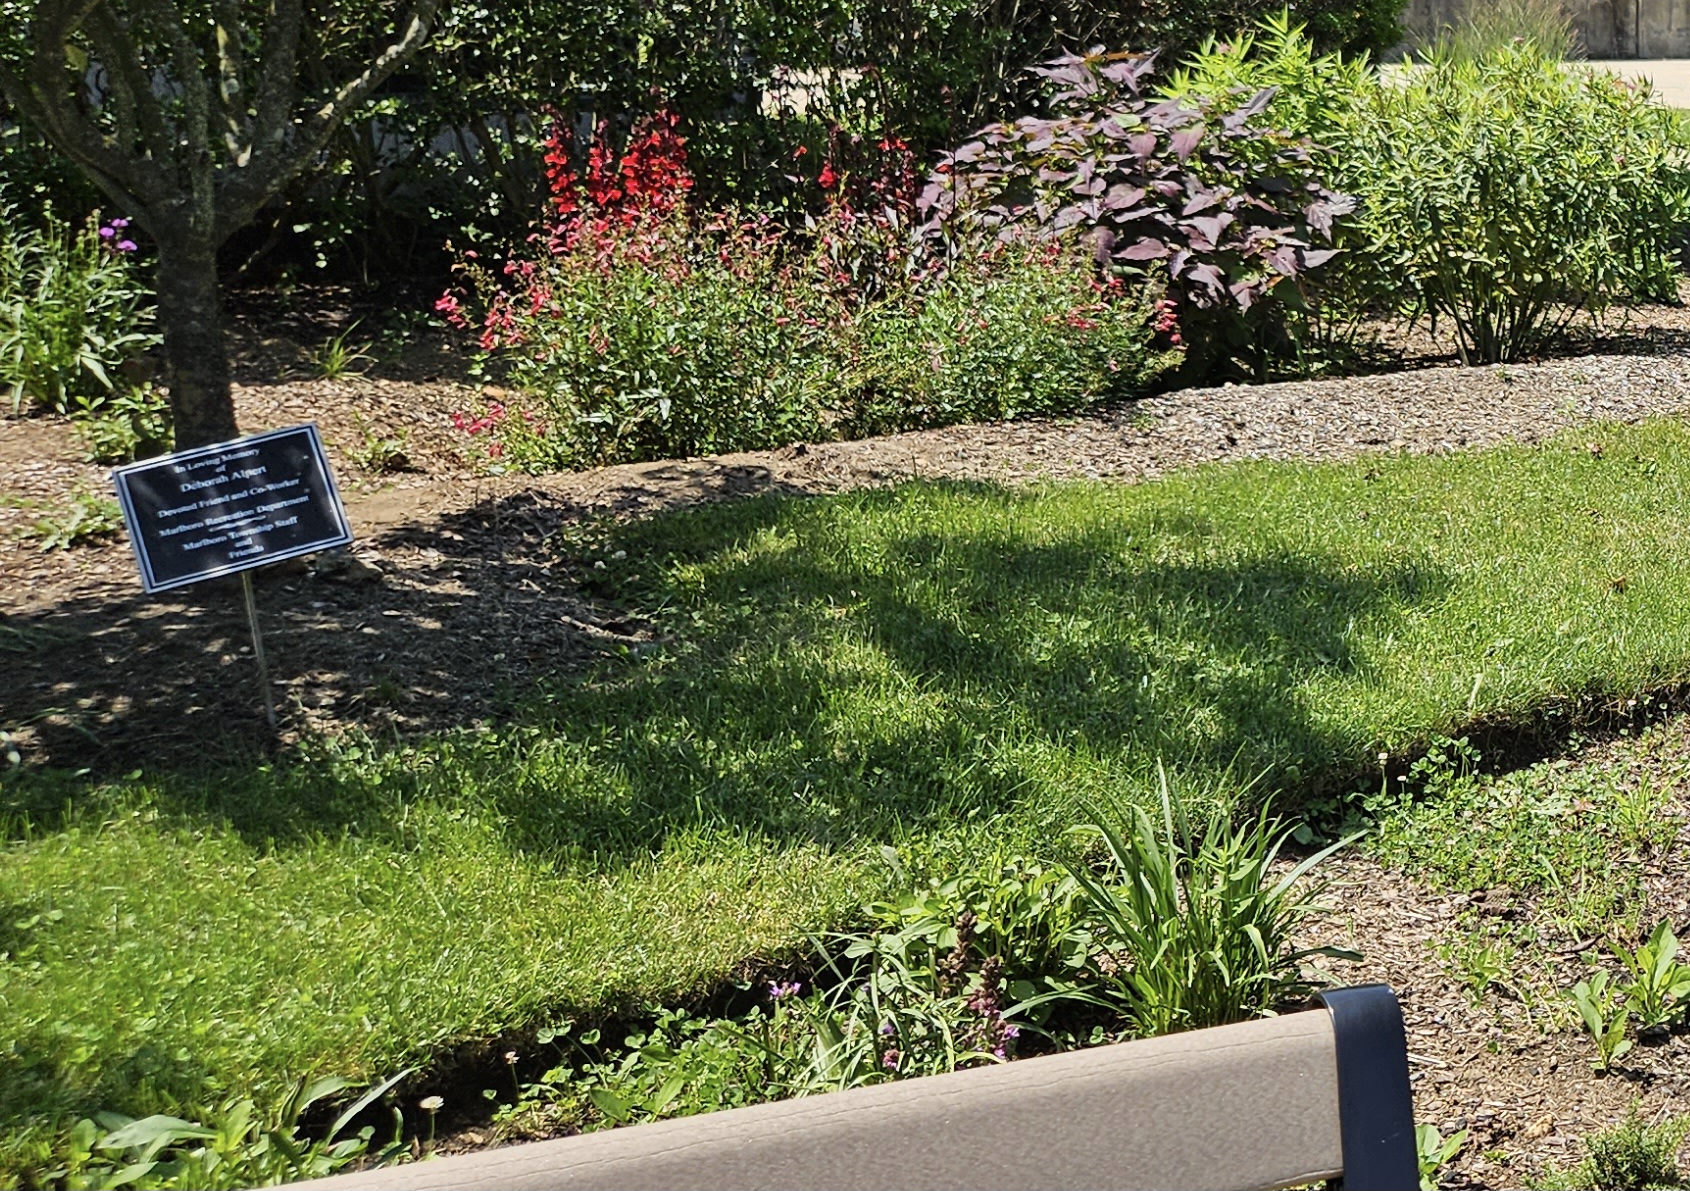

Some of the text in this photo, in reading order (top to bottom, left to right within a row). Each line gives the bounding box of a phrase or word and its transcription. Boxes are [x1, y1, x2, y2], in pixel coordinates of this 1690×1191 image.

[174, 449, 260, 473] In Loving Memory
[215, 464, 226, 473] of
[180, 475, 229, 492] Deborah
[199, 494, 230, 507] Friend
[231, 490, 249, 500] and
[249, 479, 299, 495] Co-Worker
[159, 495, 310, 537] Marlboro Recreation Department
[183, 516, 298, 550] Marlboro Township Staff
[235, 537, 253, 547] and
[228, 545, 264, 559] Friends
